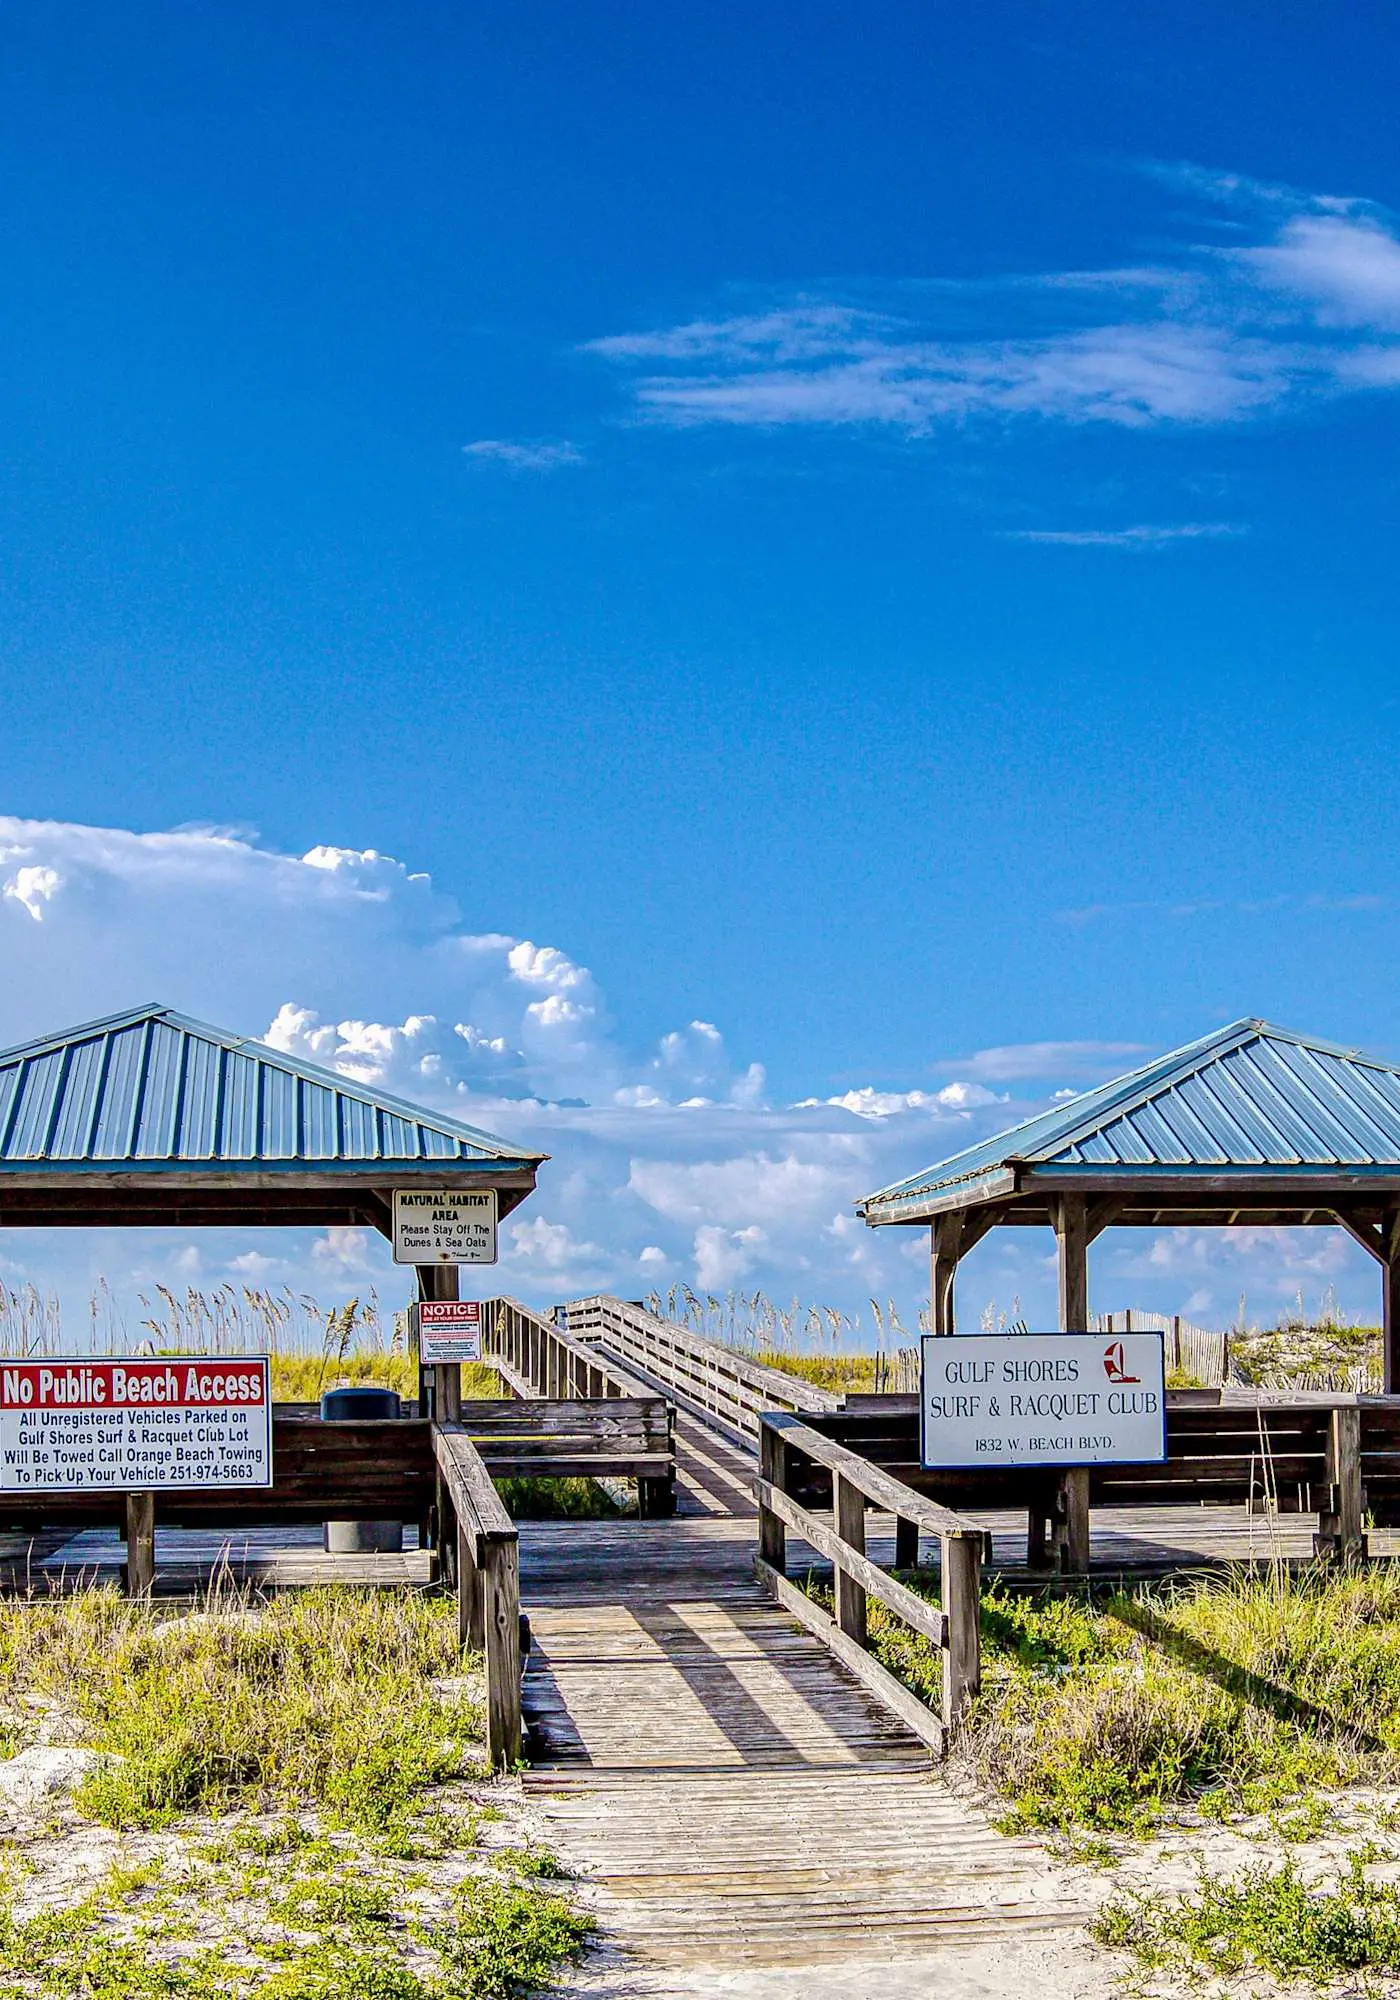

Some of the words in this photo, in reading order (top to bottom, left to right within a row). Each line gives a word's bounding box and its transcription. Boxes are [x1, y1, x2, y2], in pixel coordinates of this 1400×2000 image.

[400, 1195, 445, 1206] NATURAL
[449, 1195, 489, 1206] HABITAT
[431, 1211, 459, 1221] AREA
[400, 1225, 429, 1234] Please
[433, 1225, 453, 1236] Stay
[456, 1225, 471, 1234] Off
[473, 1225, 490, 1234] The
[404, 1238, 431, 1247] Dunes
[435, 1238, 442, 1247] &
[445, 1238, 462, 1247] Sea
[466, 1238, 487, 1247] Oats
[423, 1304, 477, 1316] NOTICE
[944, 1361, 995, 1383] GULF
[1002, 1359, 1079, 1382] SHORES
[3, 1369, 34, 1404] No
[39, 1369, 106, 1403] Public
[112, 1368, 179, 1402] Beach
[184, 1367, 262, 1401] Access
[930, 1395, 981, 1418] SURF
[988, 1396, 1001, 1416] &
[1010, 1393, 1100, 1421] RACQUET
[1107, 1392, 1158, 1415] CLUB
[20, 1412, 36, 1426] All
[41, 1411, 124, 1429] Unregistered
[128, 1410, 181, 1424] Vehicles
[185, 1409, 228, 1424] Parked
[232, 1412, 247, 1423] on
[19, 1430, 45, 1445] Gulf
[49, 1430, 93, 1444] Shores
[97, 1429, 123, 1444] Surf
[128, 1429, 137, 1443] &
[141, 1429, 194, 1446] Racquet
[197, 1428, 225, 1442] Club
[229, 1428, 249, 1441] Lot
[975, 1438, 1002, 1452] 1832
[1007, 1438, 1023, 1451] W.
[1029, 1436, 1073, 1450] BEACH
[1078, 1436, 1116, 1449] BLVD.
[4, 1450, 28, 1464] Will
[33, 1450, 49, 1464] Be
[53, 1449, 94, 1463] Towed
[98, 1448, 122, 1462] Call
[127, 1448, 172, 1464] Orange
[176, 1447, 214, 1461] Beach
[218, 1446, 262, 1463] Towing
[15, 1469, 30, 1483] To
[35, 1468, 62, 1482] Pick
[66, 1468, 84, 1485] Up
[88, 1467, 116, 1481] Your
[119, 1466, 166, 1480] Vehicle
[170, 1464, 253, 1480] 251-974-5663
